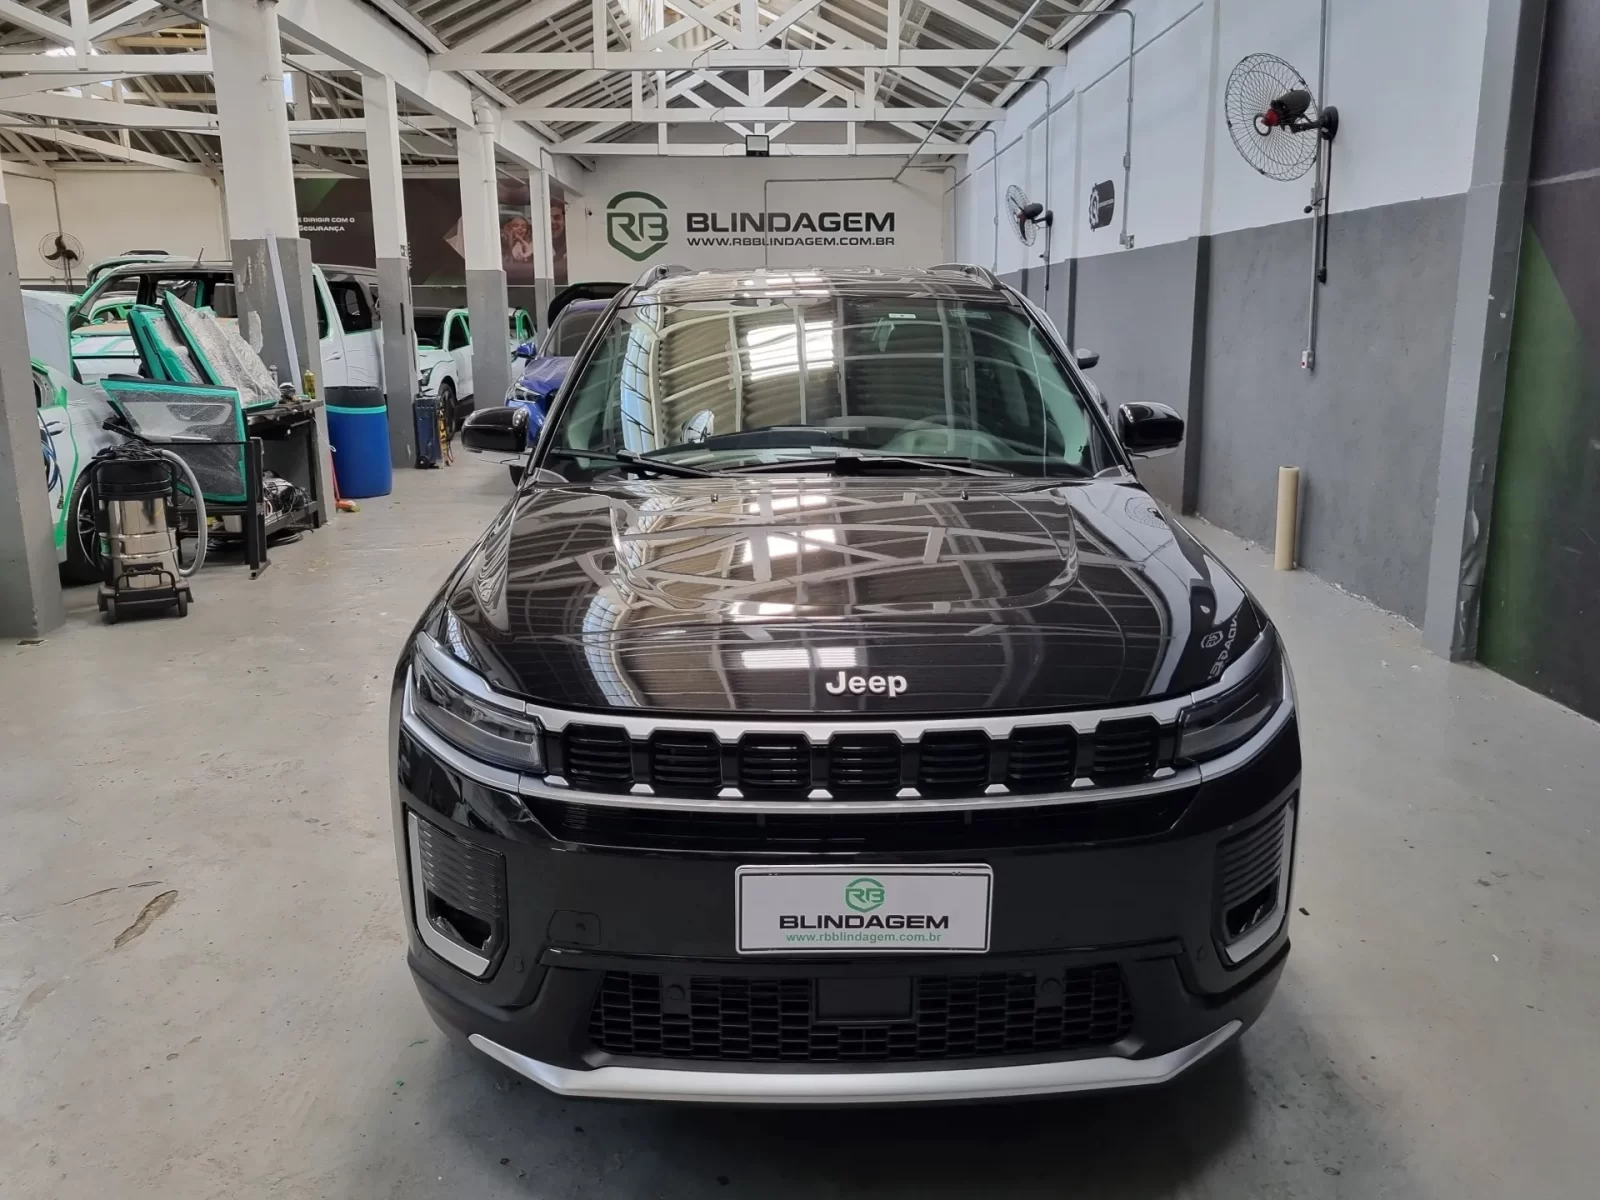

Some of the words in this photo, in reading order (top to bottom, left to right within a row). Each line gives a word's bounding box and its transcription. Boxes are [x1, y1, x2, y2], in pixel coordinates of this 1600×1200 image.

[686, 212, 895, 232] BLINDAGEM
[687, 237, 895, 246] WWW.RBBLINDAGEM.COM.BR
[825, 671, 907, 697] Jeep
[779, 915, 949, 930] BLINDAGEM
[786, 932, 942, 942] www.rbblindagem.com.br
